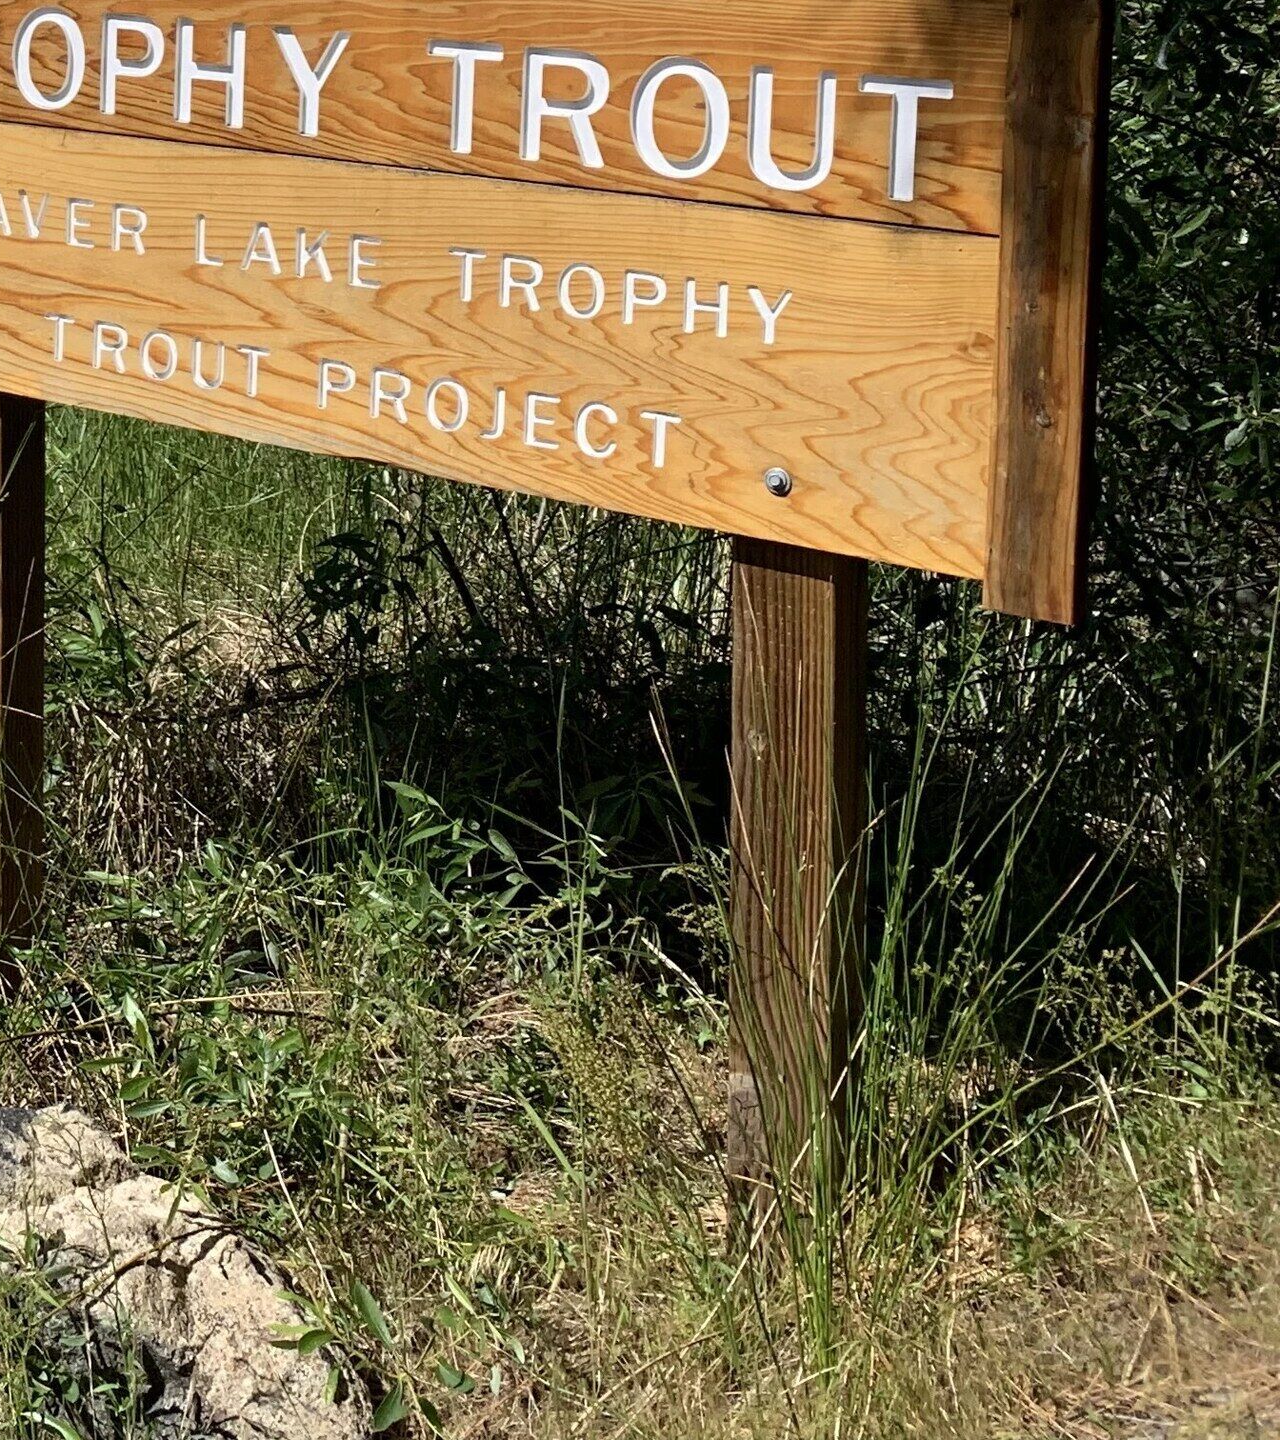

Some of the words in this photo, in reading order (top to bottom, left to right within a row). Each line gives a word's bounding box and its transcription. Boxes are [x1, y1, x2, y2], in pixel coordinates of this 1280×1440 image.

[428, 41, 953, 202] TROUT
[196, 213, 379, 288] LAKE
[450, 249, 792, 344] TROPHY
[47, 314, 269, 396] TROUT
[317, 360, 681, 467] PROJECT
